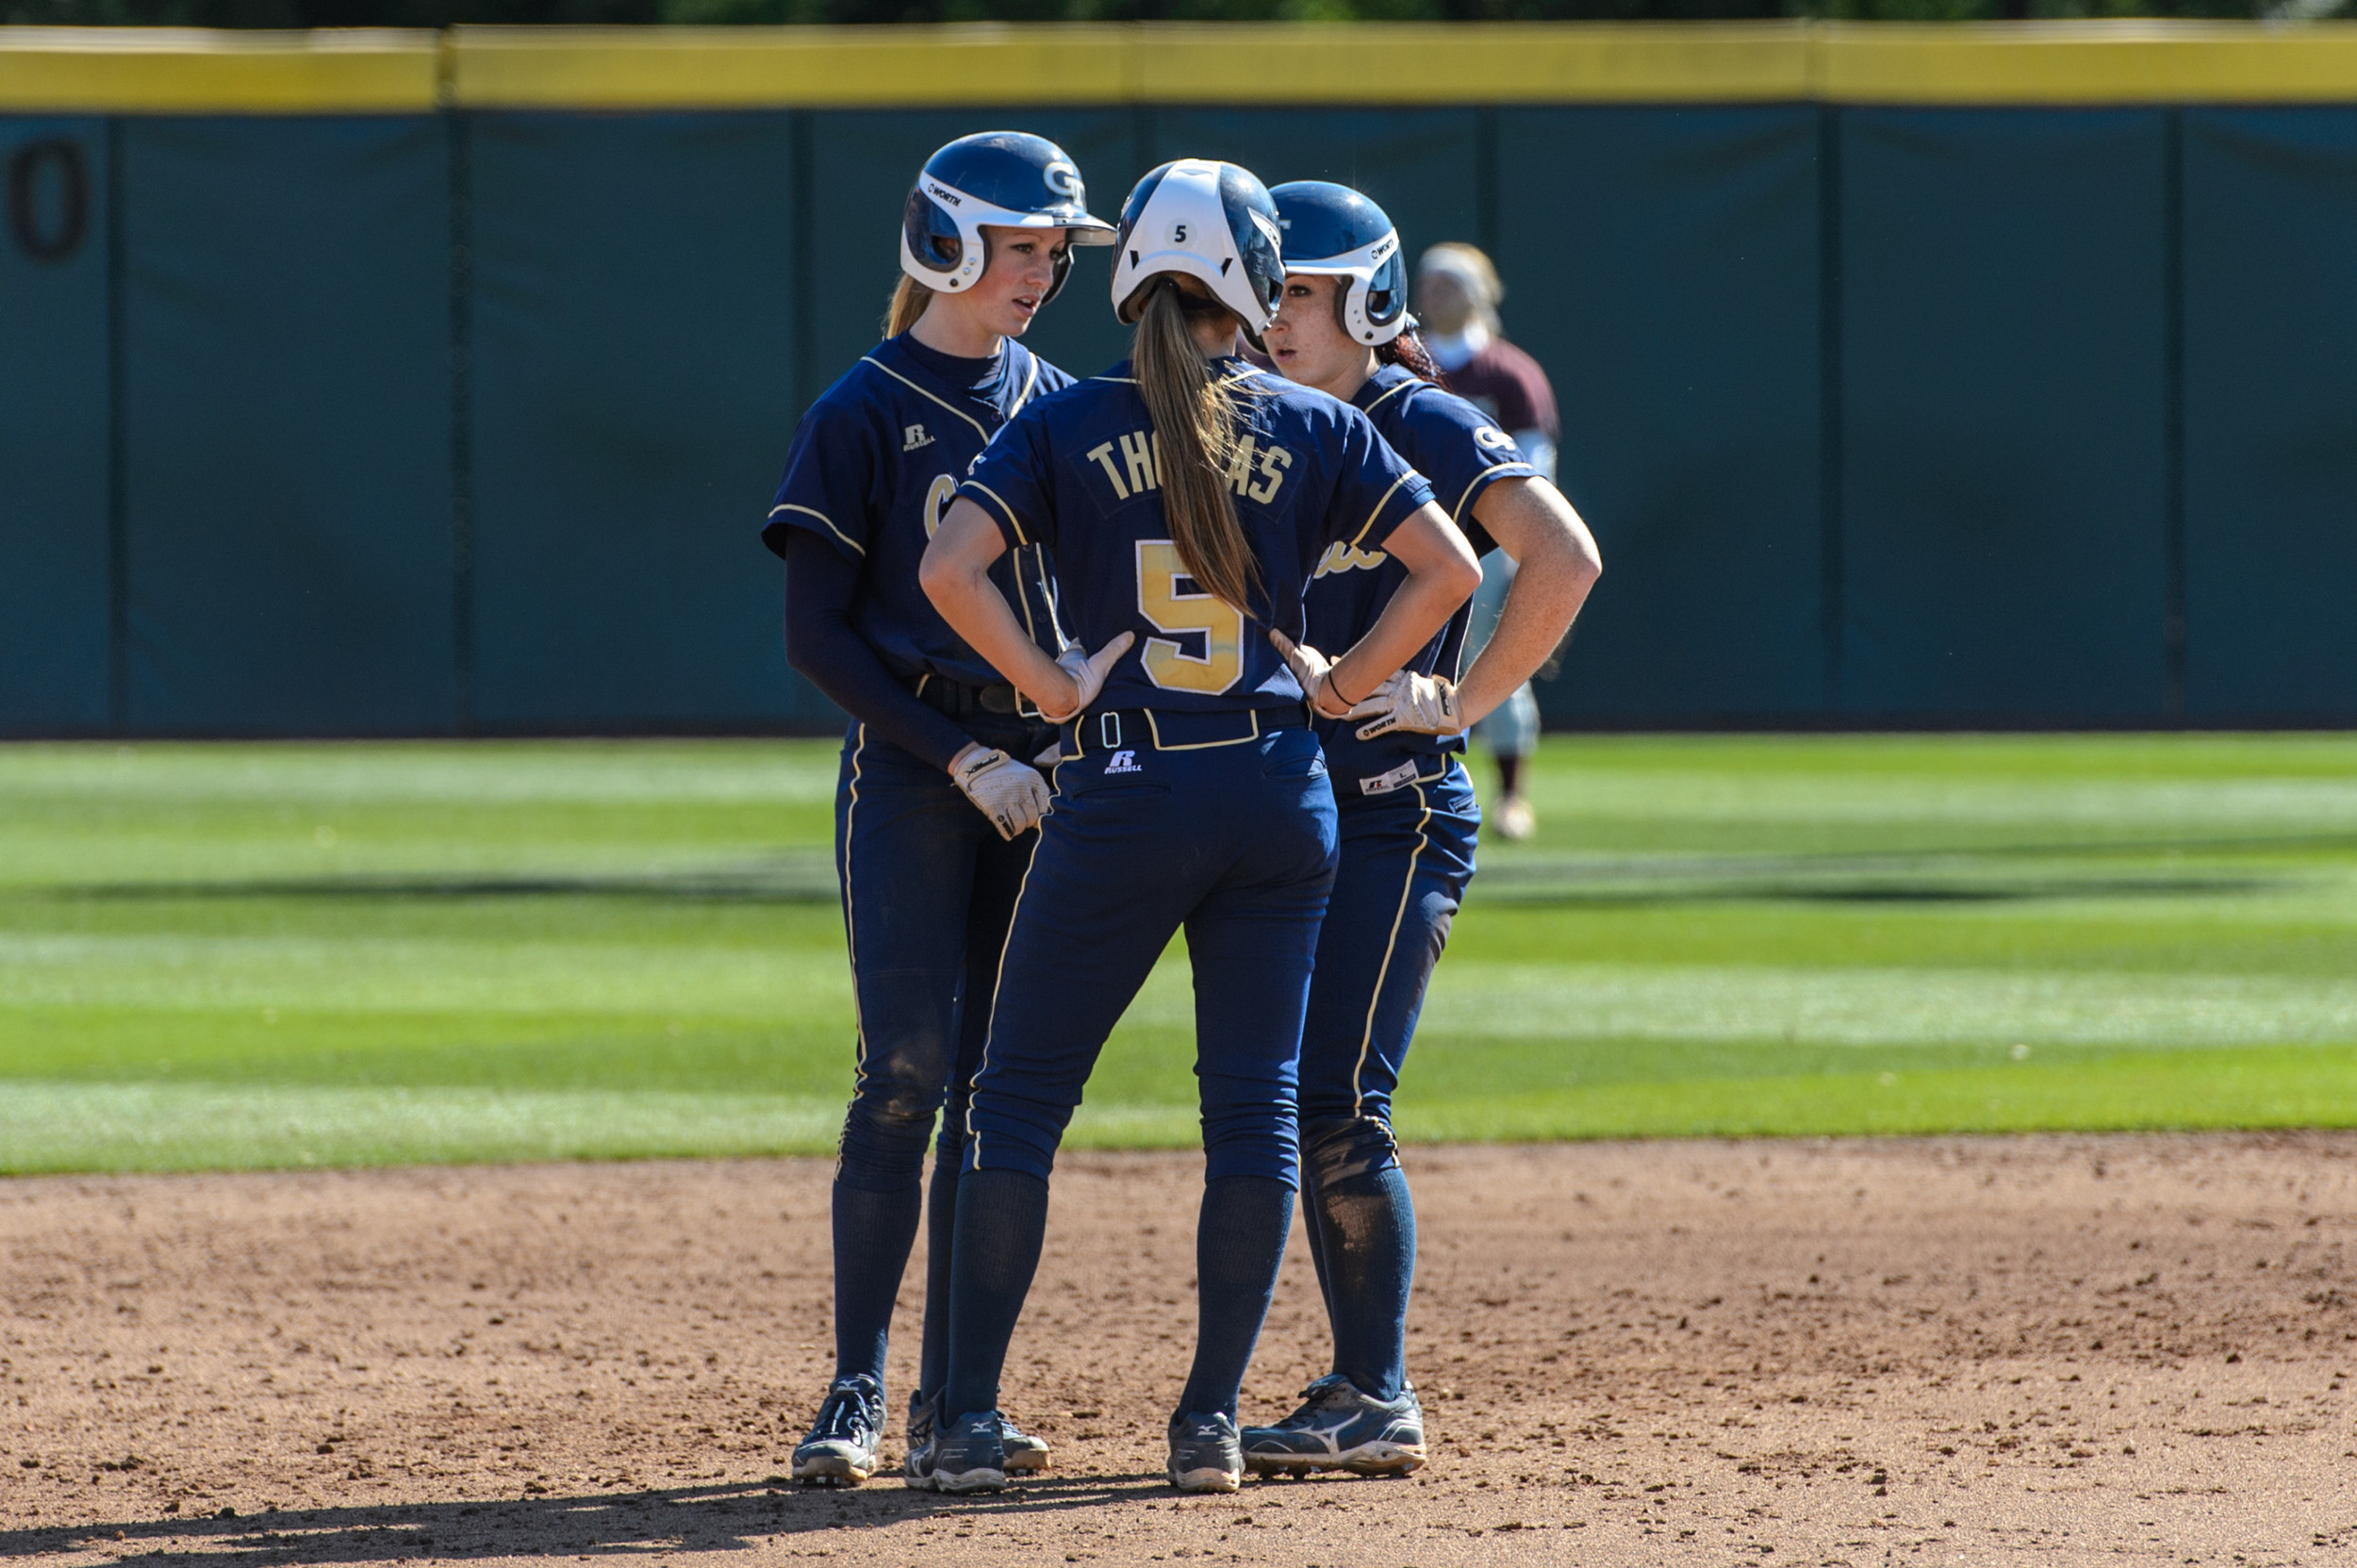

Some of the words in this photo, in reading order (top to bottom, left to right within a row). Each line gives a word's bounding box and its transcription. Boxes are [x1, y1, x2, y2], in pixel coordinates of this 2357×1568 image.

[6, 133, 90, 267] 0
[933, 186, 962, 206] WORTH
[1175, 224, 1187, 243] 5
[1086, 430, 1293, 504] THAS
[1135, 539, 1244, 696] 5
[1369, 717, 1396, 734] WORTH
[1104, 765, 1143, 774] RUSSELL
